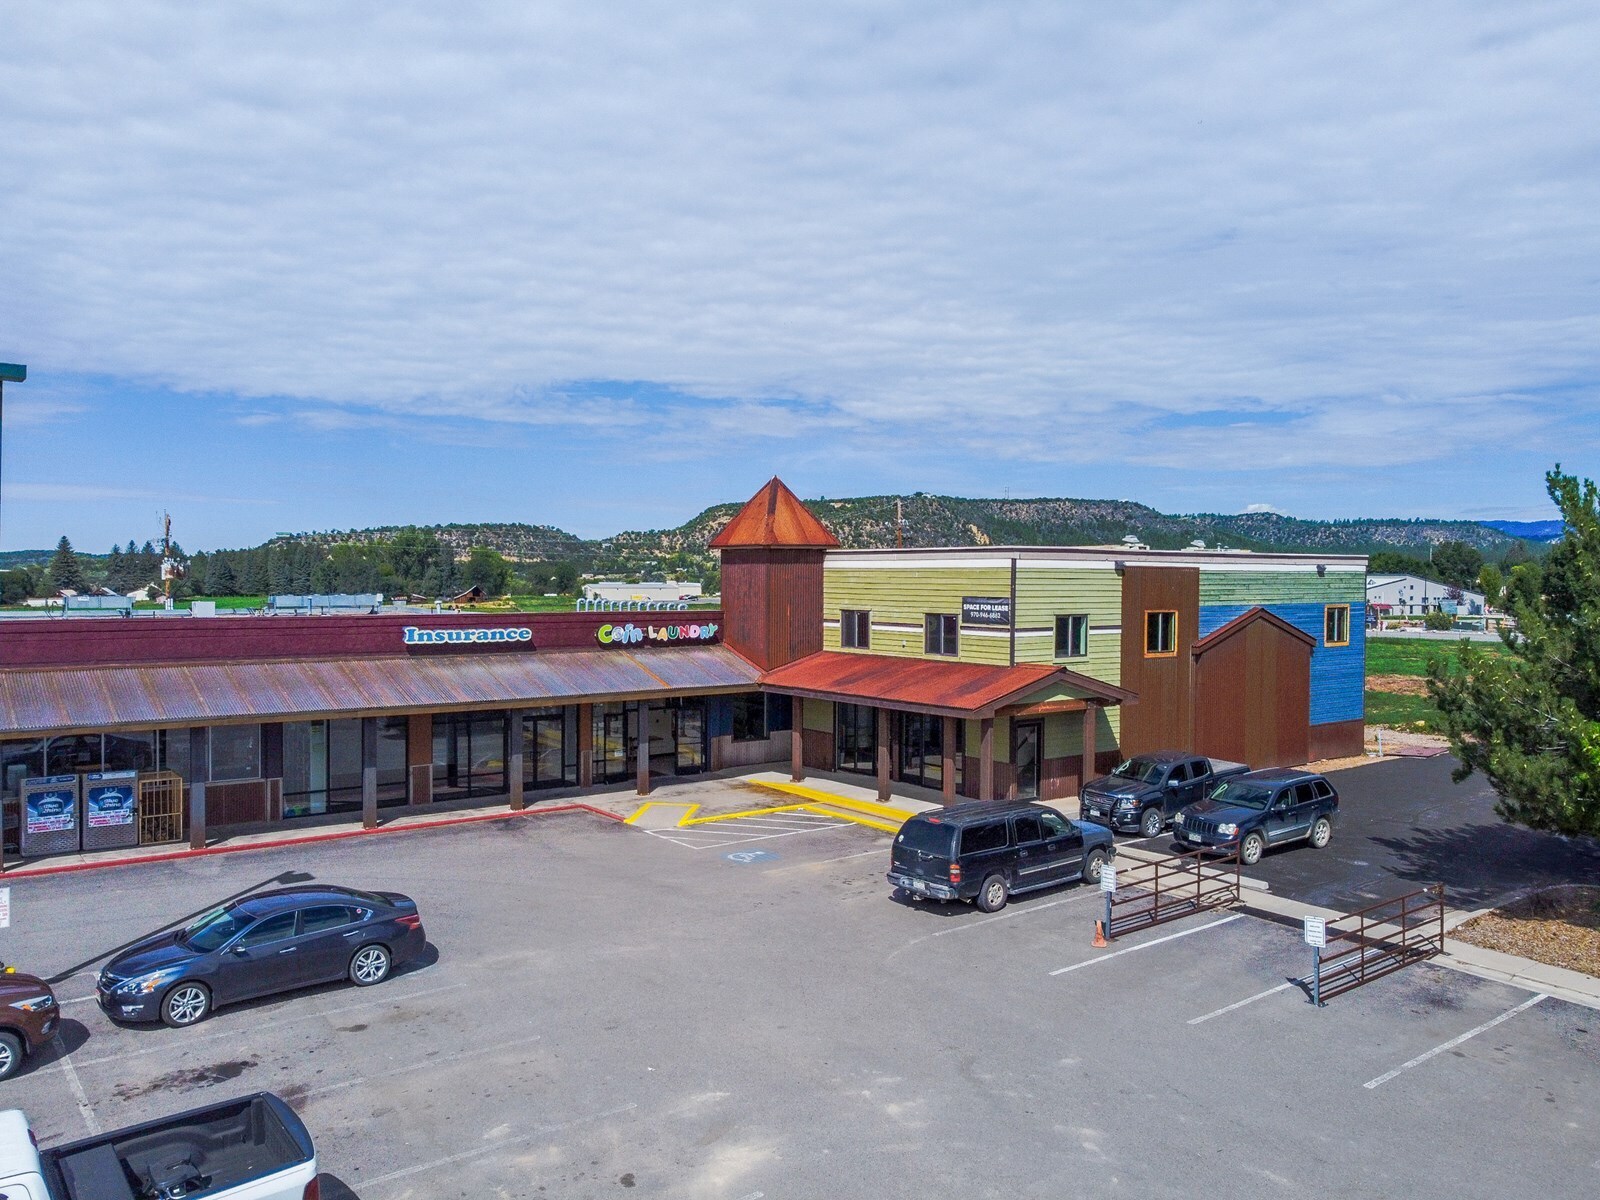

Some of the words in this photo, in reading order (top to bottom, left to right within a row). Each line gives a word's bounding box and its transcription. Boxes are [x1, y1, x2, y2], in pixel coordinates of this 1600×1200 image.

[963, 603, 980, 611] SPACE
[991, 604, 1009, 612] LEASE
[404, 626, 532, 644] Insurance
[648, 623, 718, 641] LAUNDRY
